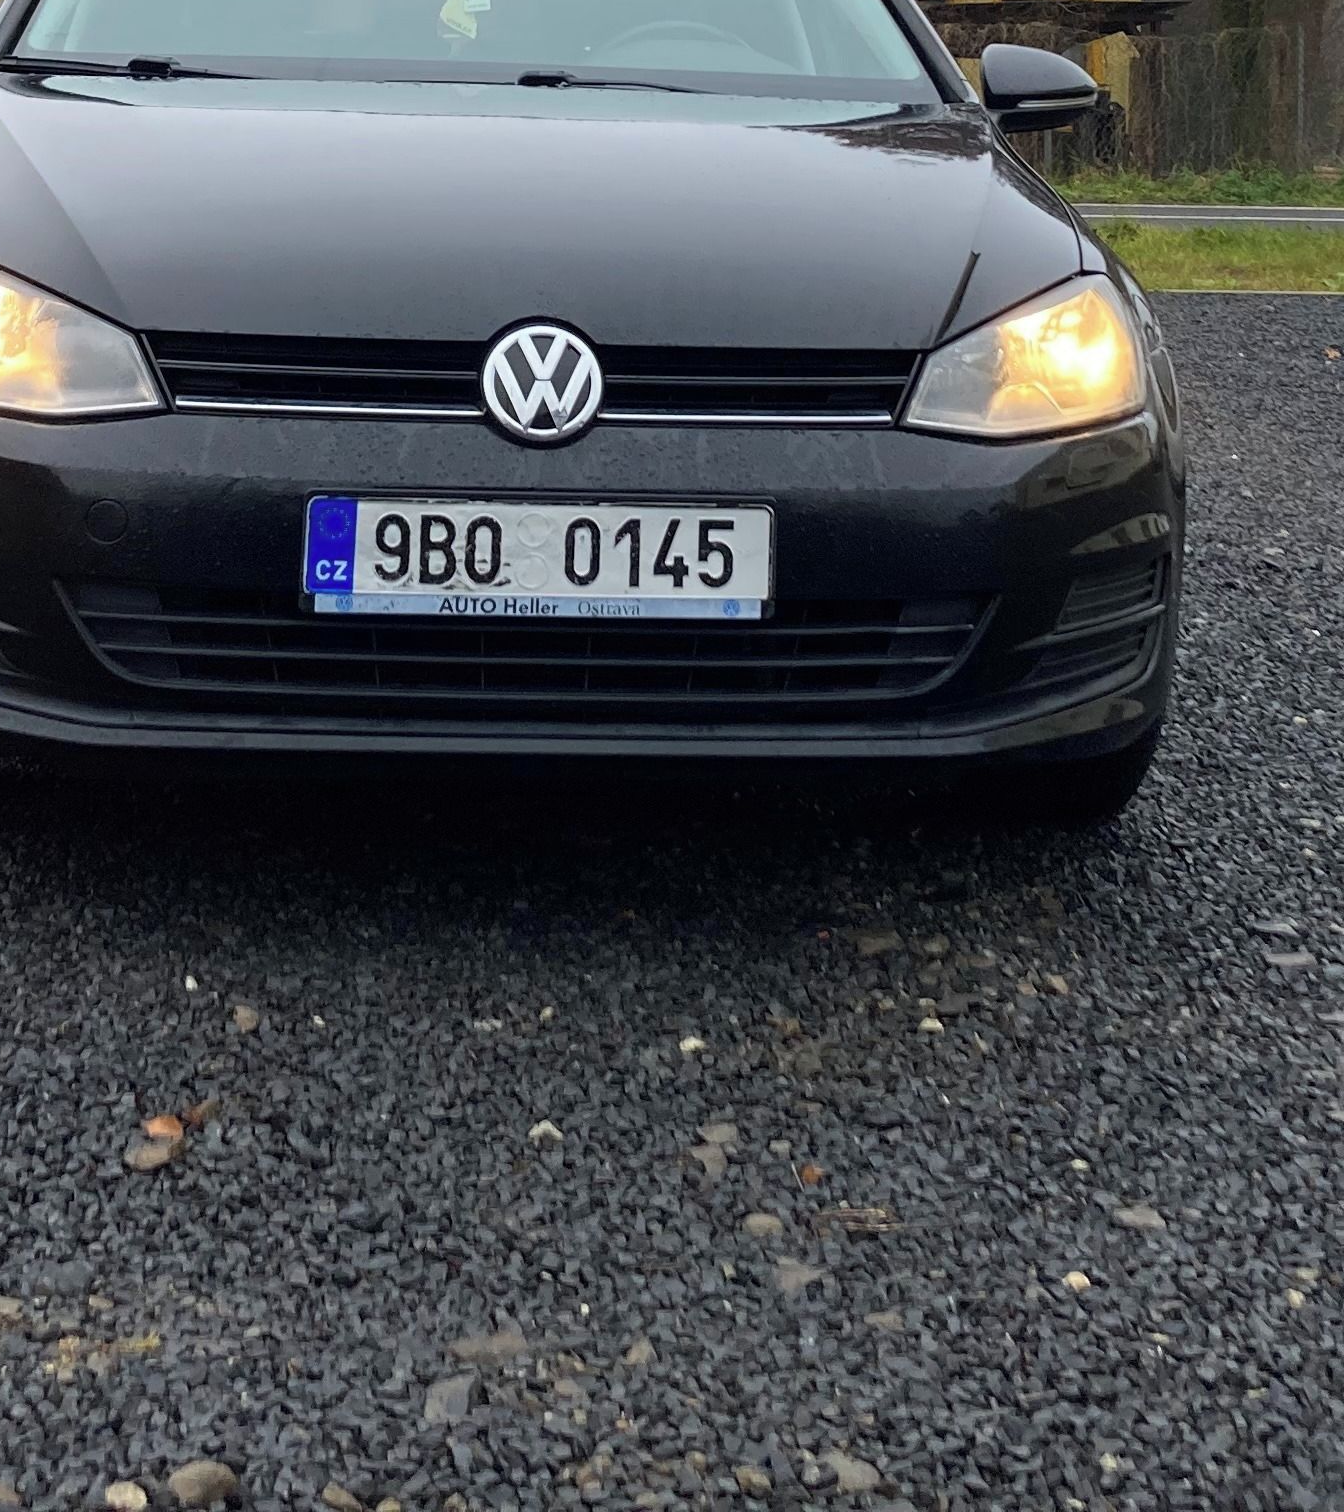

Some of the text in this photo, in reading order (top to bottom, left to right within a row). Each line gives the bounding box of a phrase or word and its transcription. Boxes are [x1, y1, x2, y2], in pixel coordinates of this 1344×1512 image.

[486, 328, 599, 436] VW
[315, 559, 348, 581] CZ
[374, 513, 735, 588] 9B0 0145
[439, 597, 641, 617] AUTO Heller Ostrava
